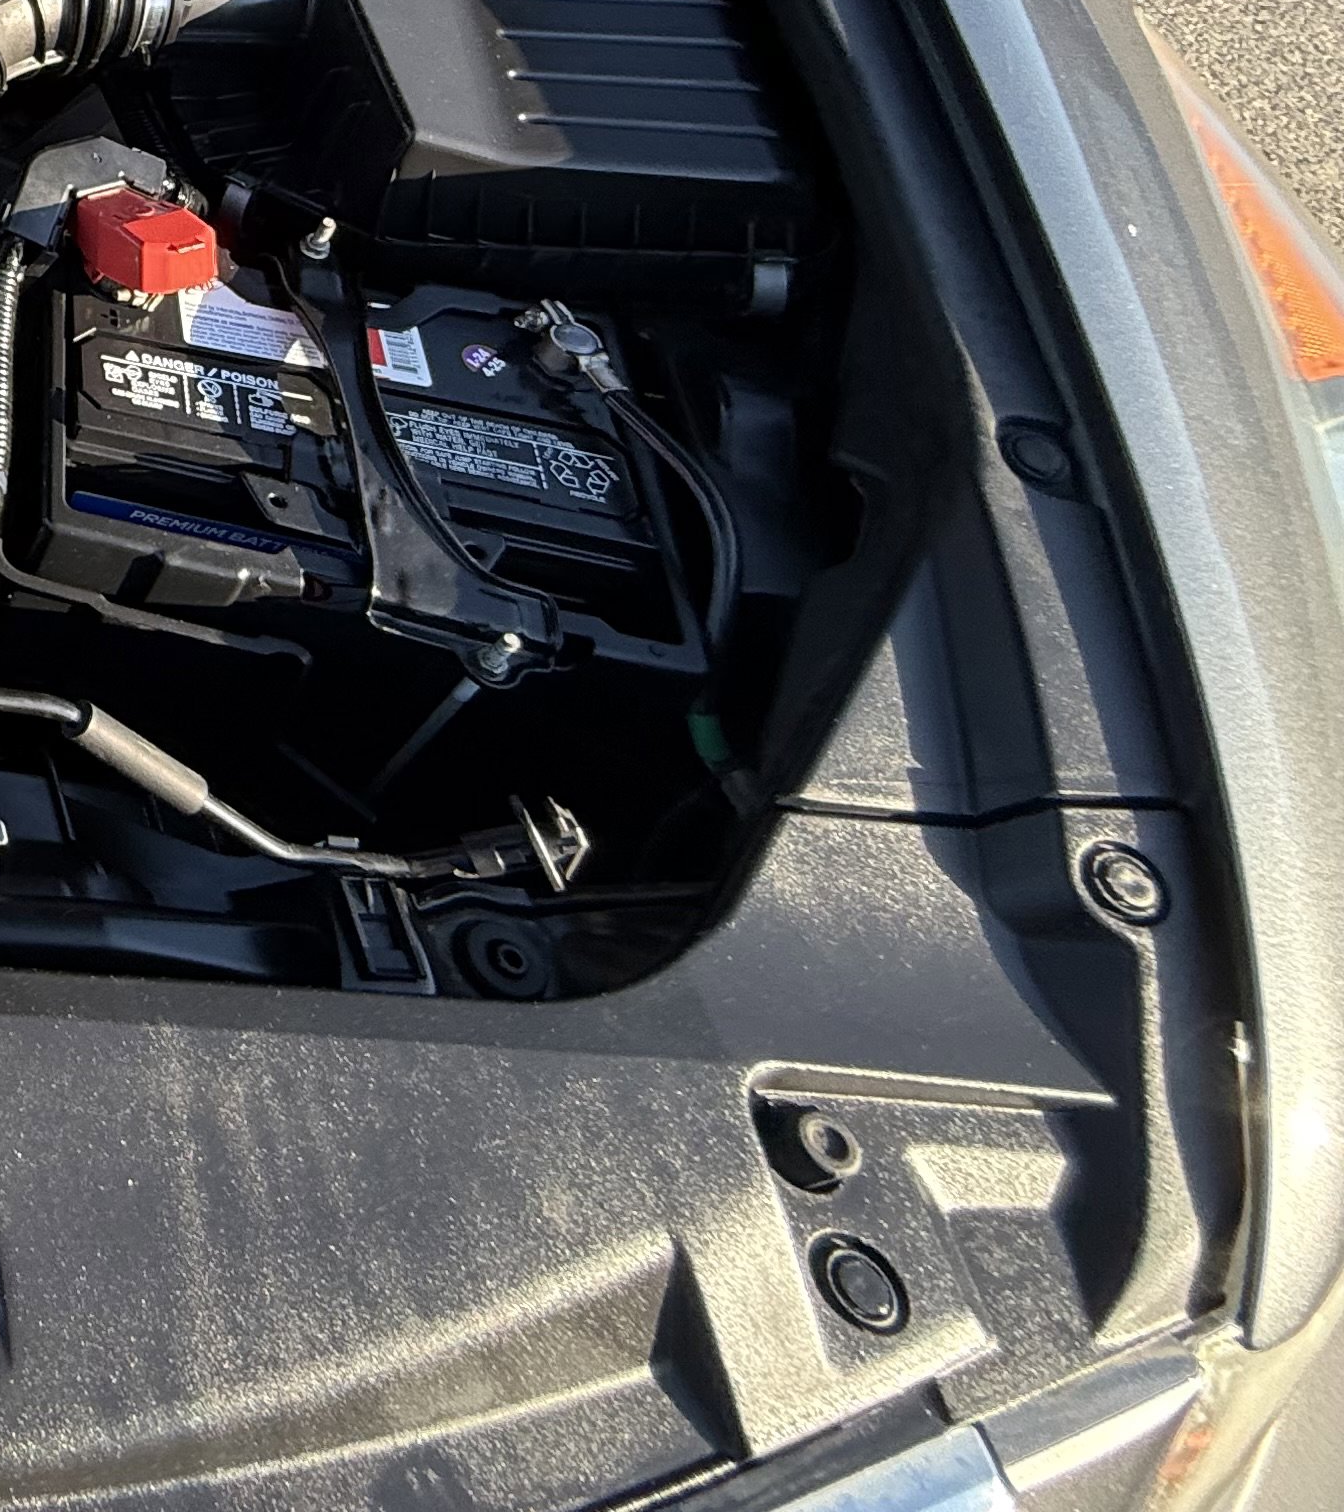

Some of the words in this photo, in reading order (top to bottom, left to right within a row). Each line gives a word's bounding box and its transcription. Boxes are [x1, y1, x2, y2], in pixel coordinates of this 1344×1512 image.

[141, 353, 205, 376] DANGER
[220, 369, 280, 390] POISON
[130, 509, 227, 539] PREMIUM
